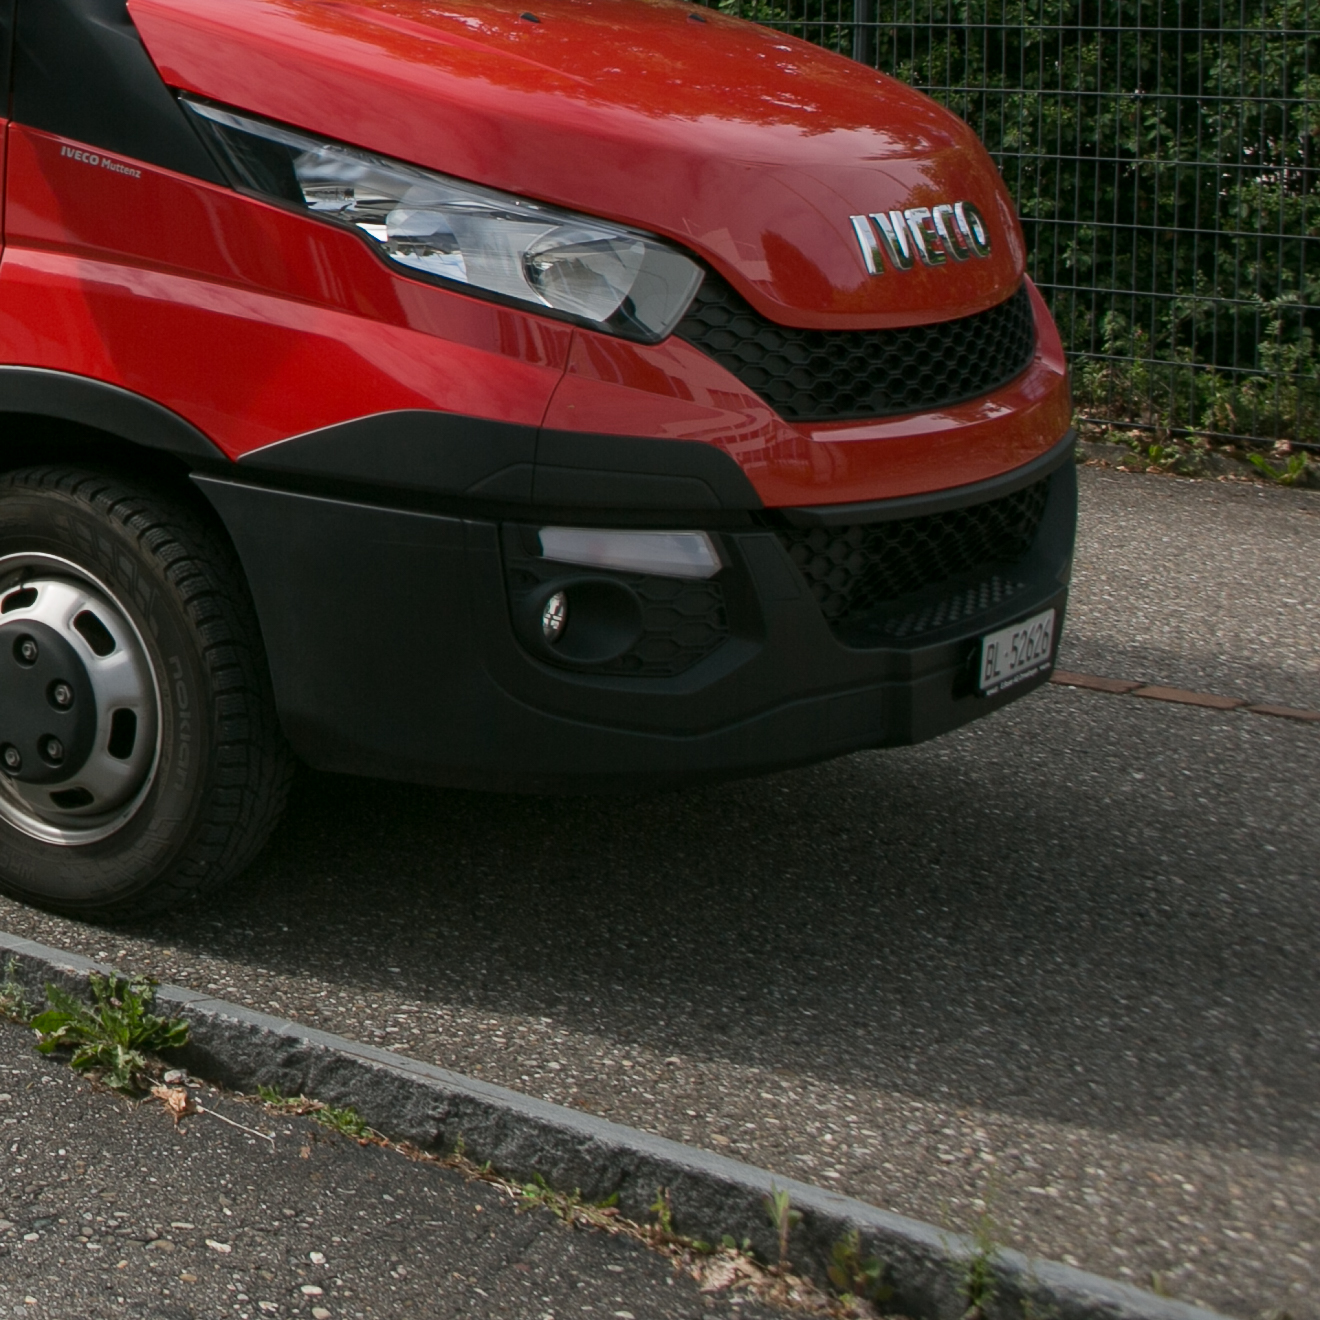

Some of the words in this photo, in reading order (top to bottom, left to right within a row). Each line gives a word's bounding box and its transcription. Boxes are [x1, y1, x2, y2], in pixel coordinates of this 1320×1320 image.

[61, 145, 100, 166] IVECO
[101, 157, 142, 179] Muttenz
[850, 200, 992, 276] IVECO
